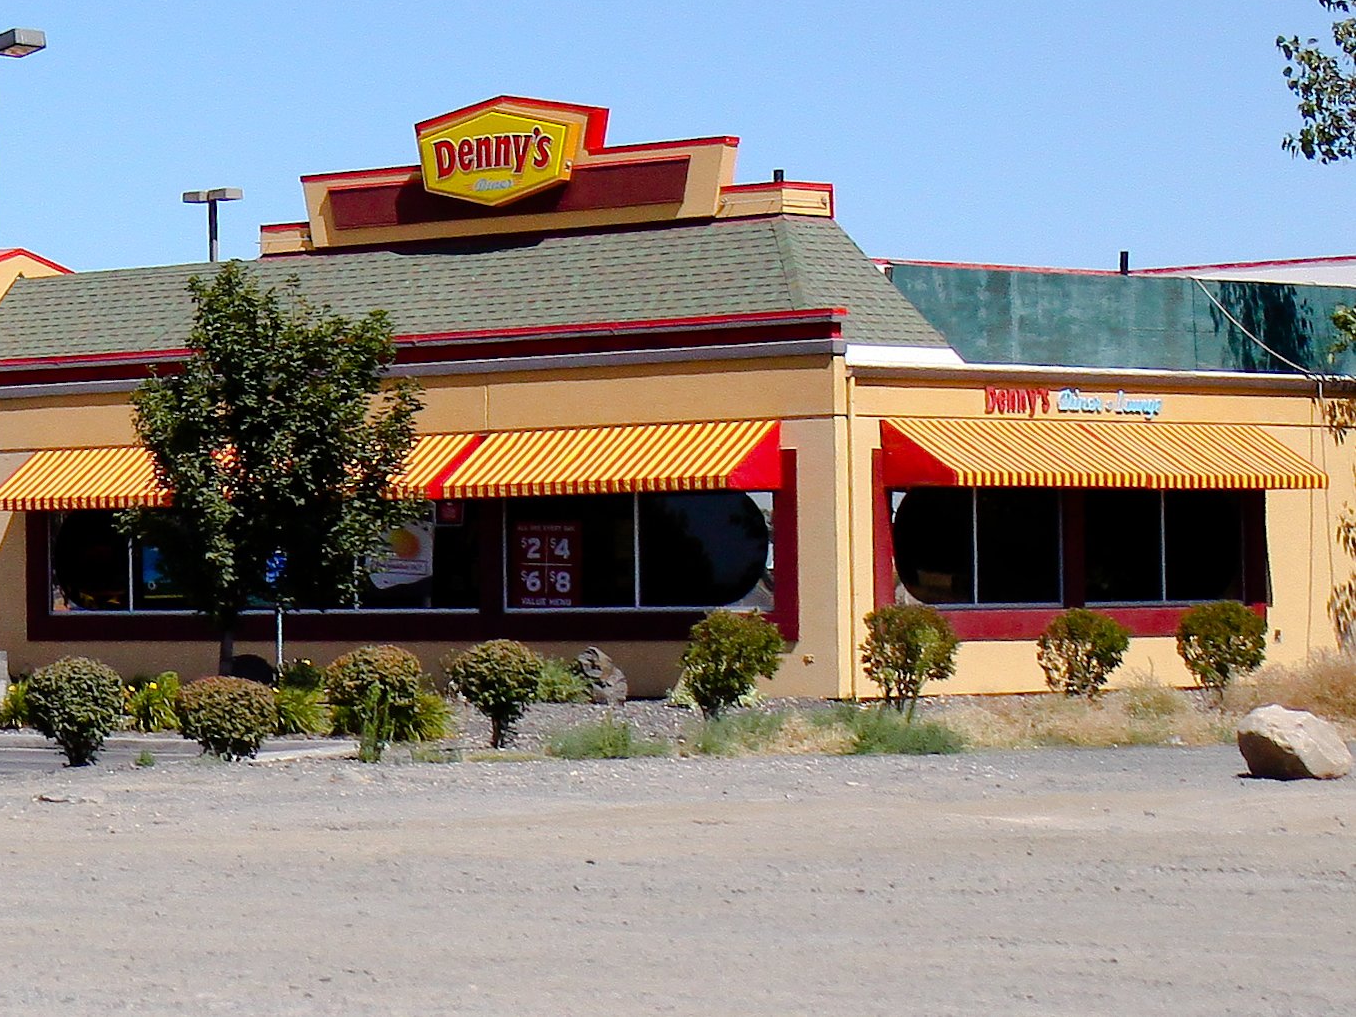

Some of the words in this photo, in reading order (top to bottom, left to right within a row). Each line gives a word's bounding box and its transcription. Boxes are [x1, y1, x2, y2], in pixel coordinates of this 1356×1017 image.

[432, 126, 554, 180] Denny's
[985, 385, 1050, 418] Denny's
[520, 536, 542, 560] $2
[549, 537, 571, 560] $4
[520, 570, 542, 593] $6
[549, 570, 572, 594] $8
[521, 597, 547, 606] VALUE
